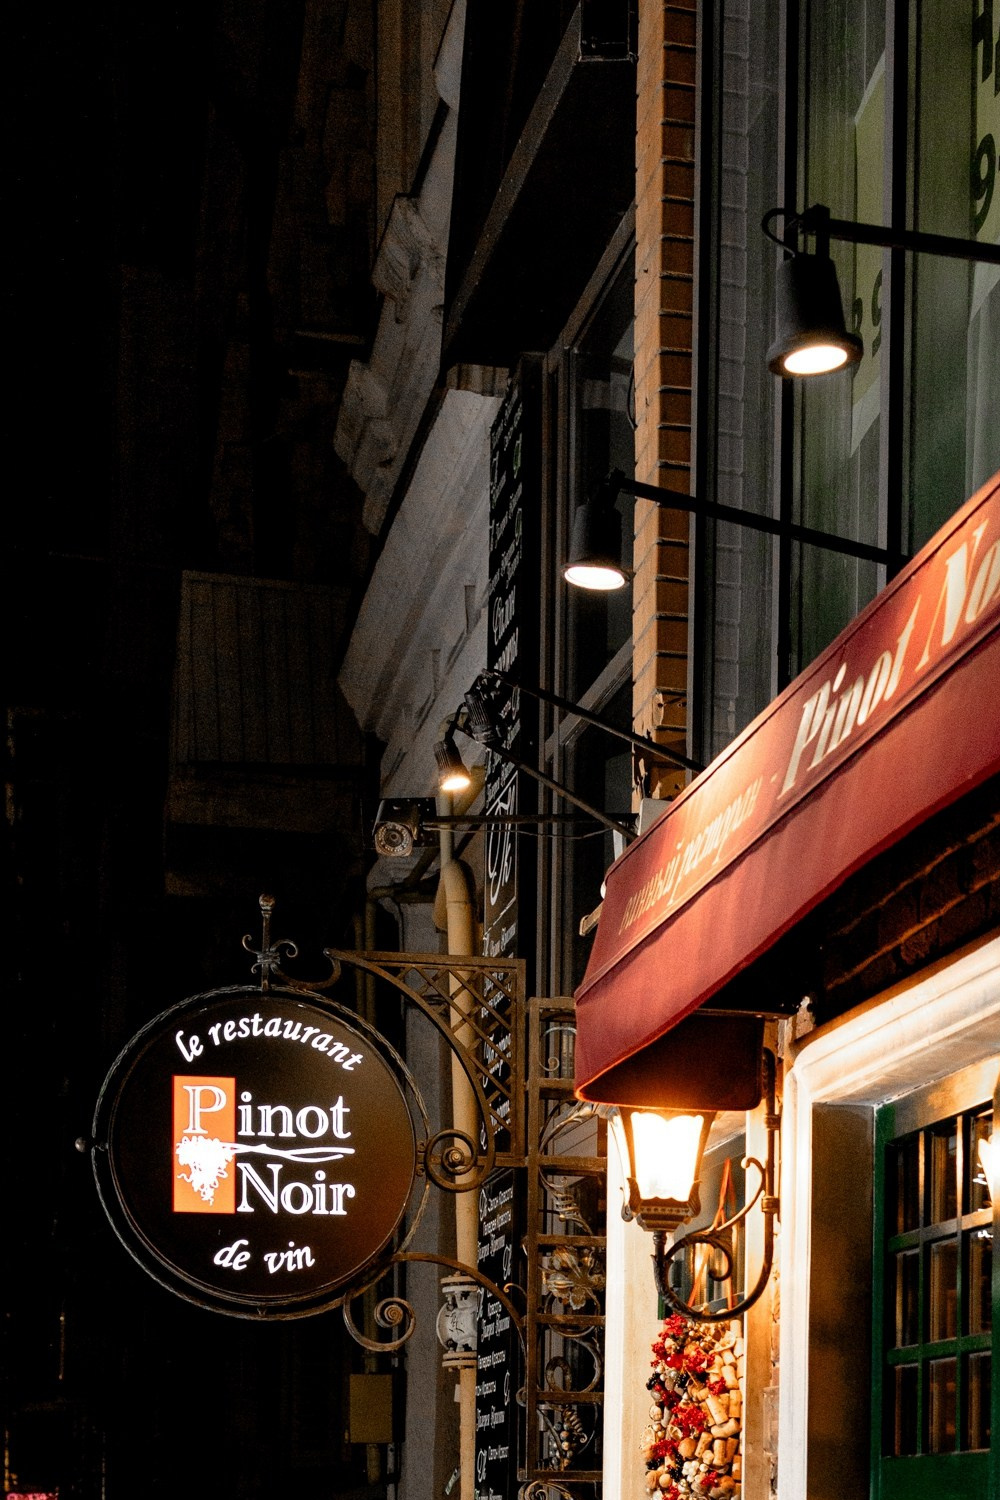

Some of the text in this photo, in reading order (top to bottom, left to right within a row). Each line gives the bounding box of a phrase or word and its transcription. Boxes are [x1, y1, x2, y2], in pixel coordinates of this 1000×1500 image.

[777, 594, 922, 800] Pinot
[175, 1012, 364, 1072] le restaurant
[181, 1084, 352, 1139] Pinot
[236, 1162, 356, 1216] Noir
[213, 1239, 316, 1275] de vin
